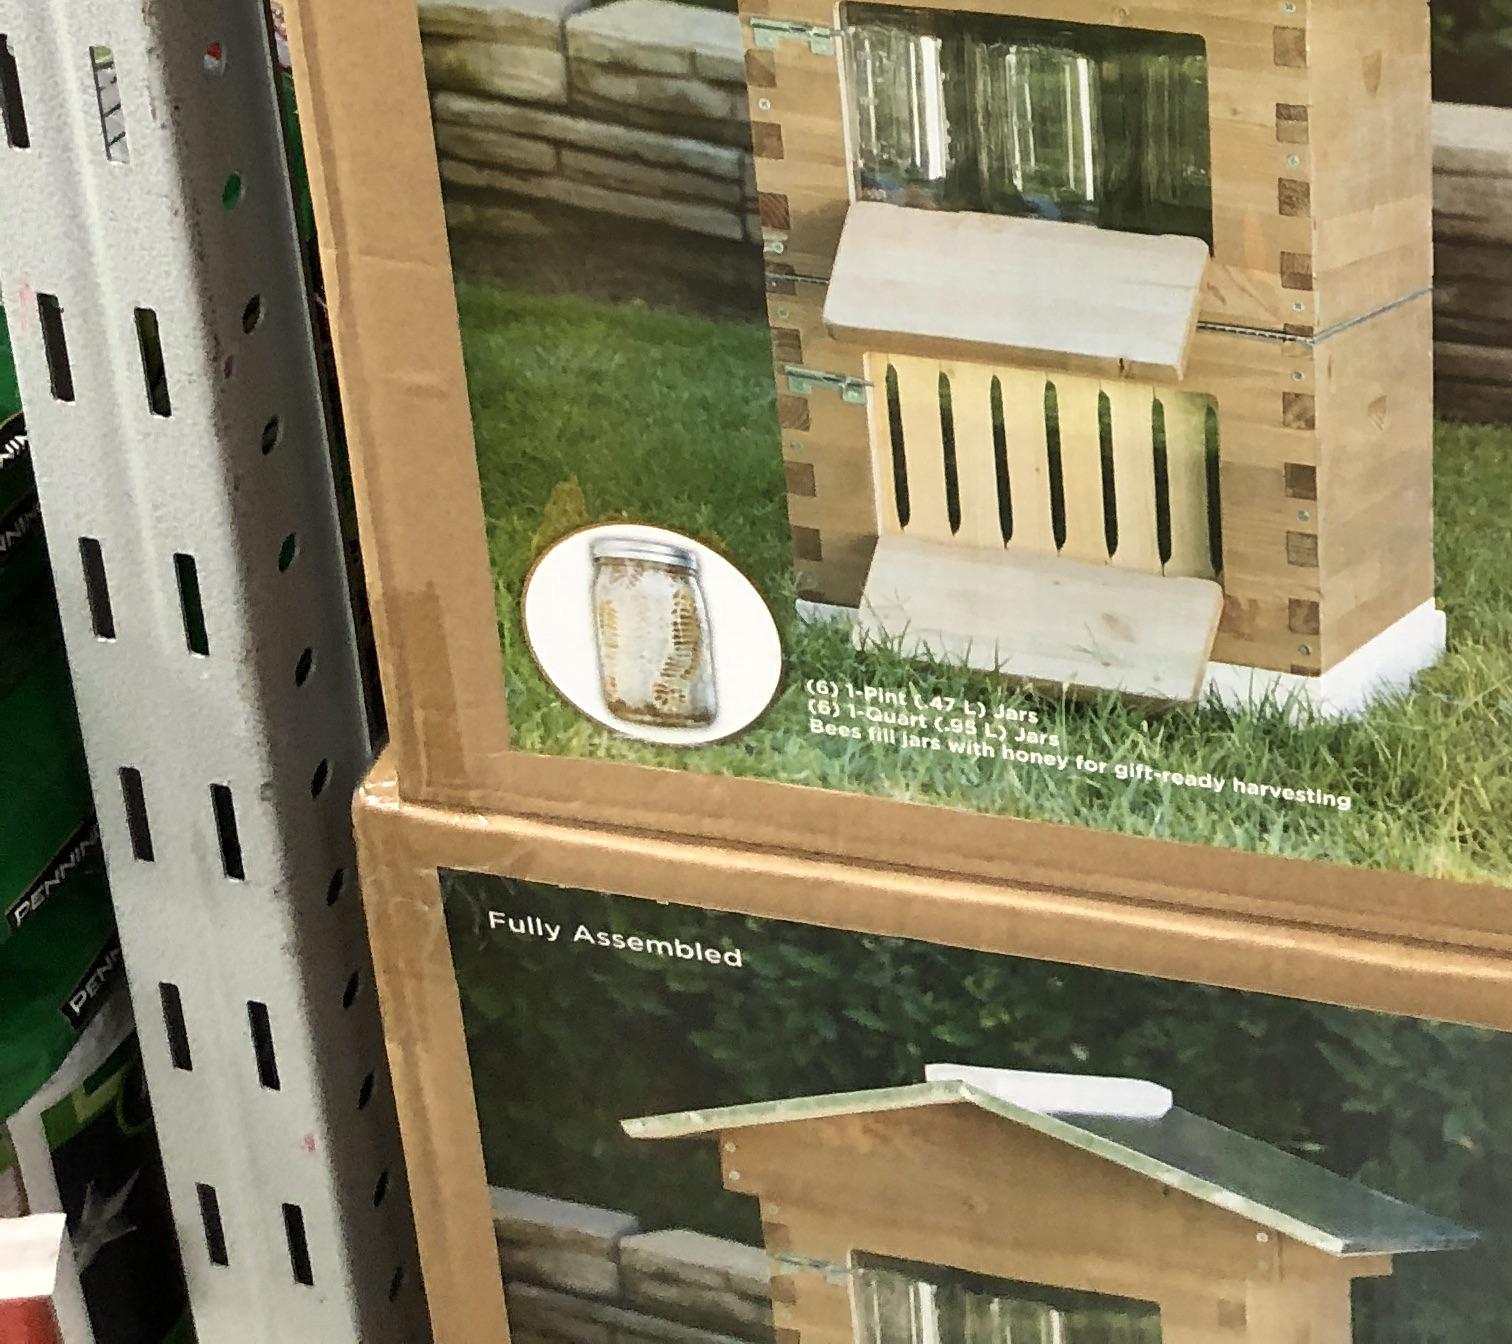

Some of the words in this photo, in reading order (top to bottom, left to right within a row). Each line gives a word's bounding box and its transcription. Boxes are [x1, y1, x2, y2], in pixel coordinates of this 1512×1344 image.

[810, 718, 861, 740] Bees
[868, 725, 895, 744] fill
[901, 733, 940, 751] jars
[949, 738, 995, 758] with
[1001, 744, 1069, 771] honey
[1075, 755, 1107, 774] for
[1114, 762, 1226, 792] gift-ready
[1233, 776, 1352, 811] harvesting
[488, 911, 560, 942] Fully
[574, 924, 742, 967] Assembled
